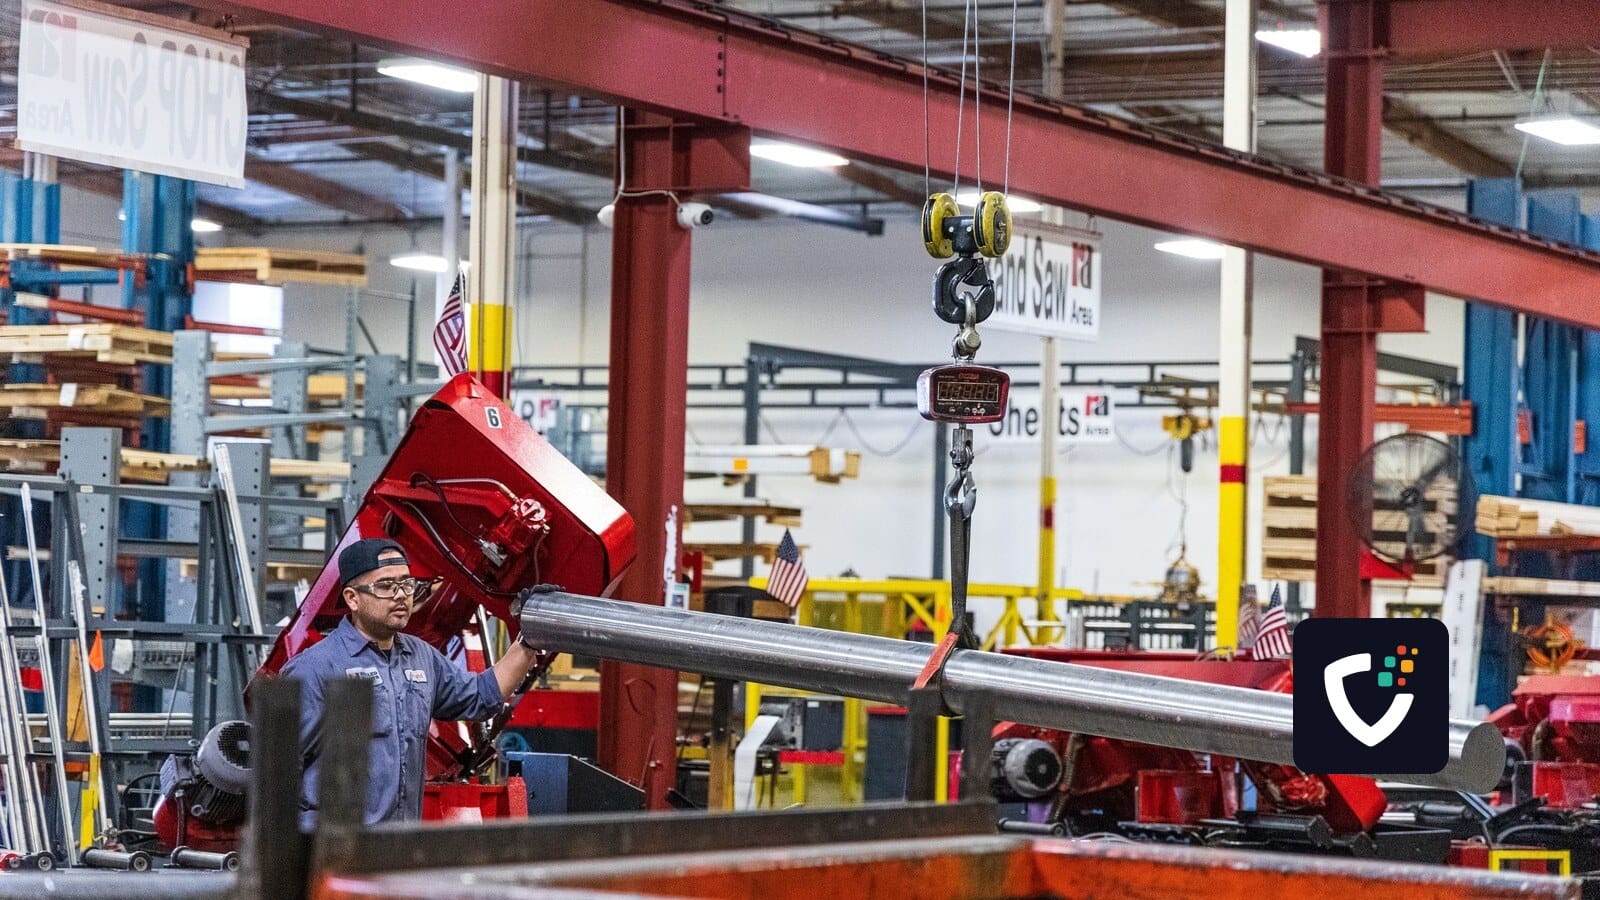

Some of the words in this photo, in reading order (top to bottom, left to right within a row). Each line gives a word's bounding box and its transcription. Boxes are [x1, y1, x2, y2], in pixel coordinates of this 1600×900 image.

[985, 233, 1028, 316] and
[1032, 235, 1069, 322] Saw
[1070, 299, 1093, 326] Area
[487, 408, 500, 427] 6
